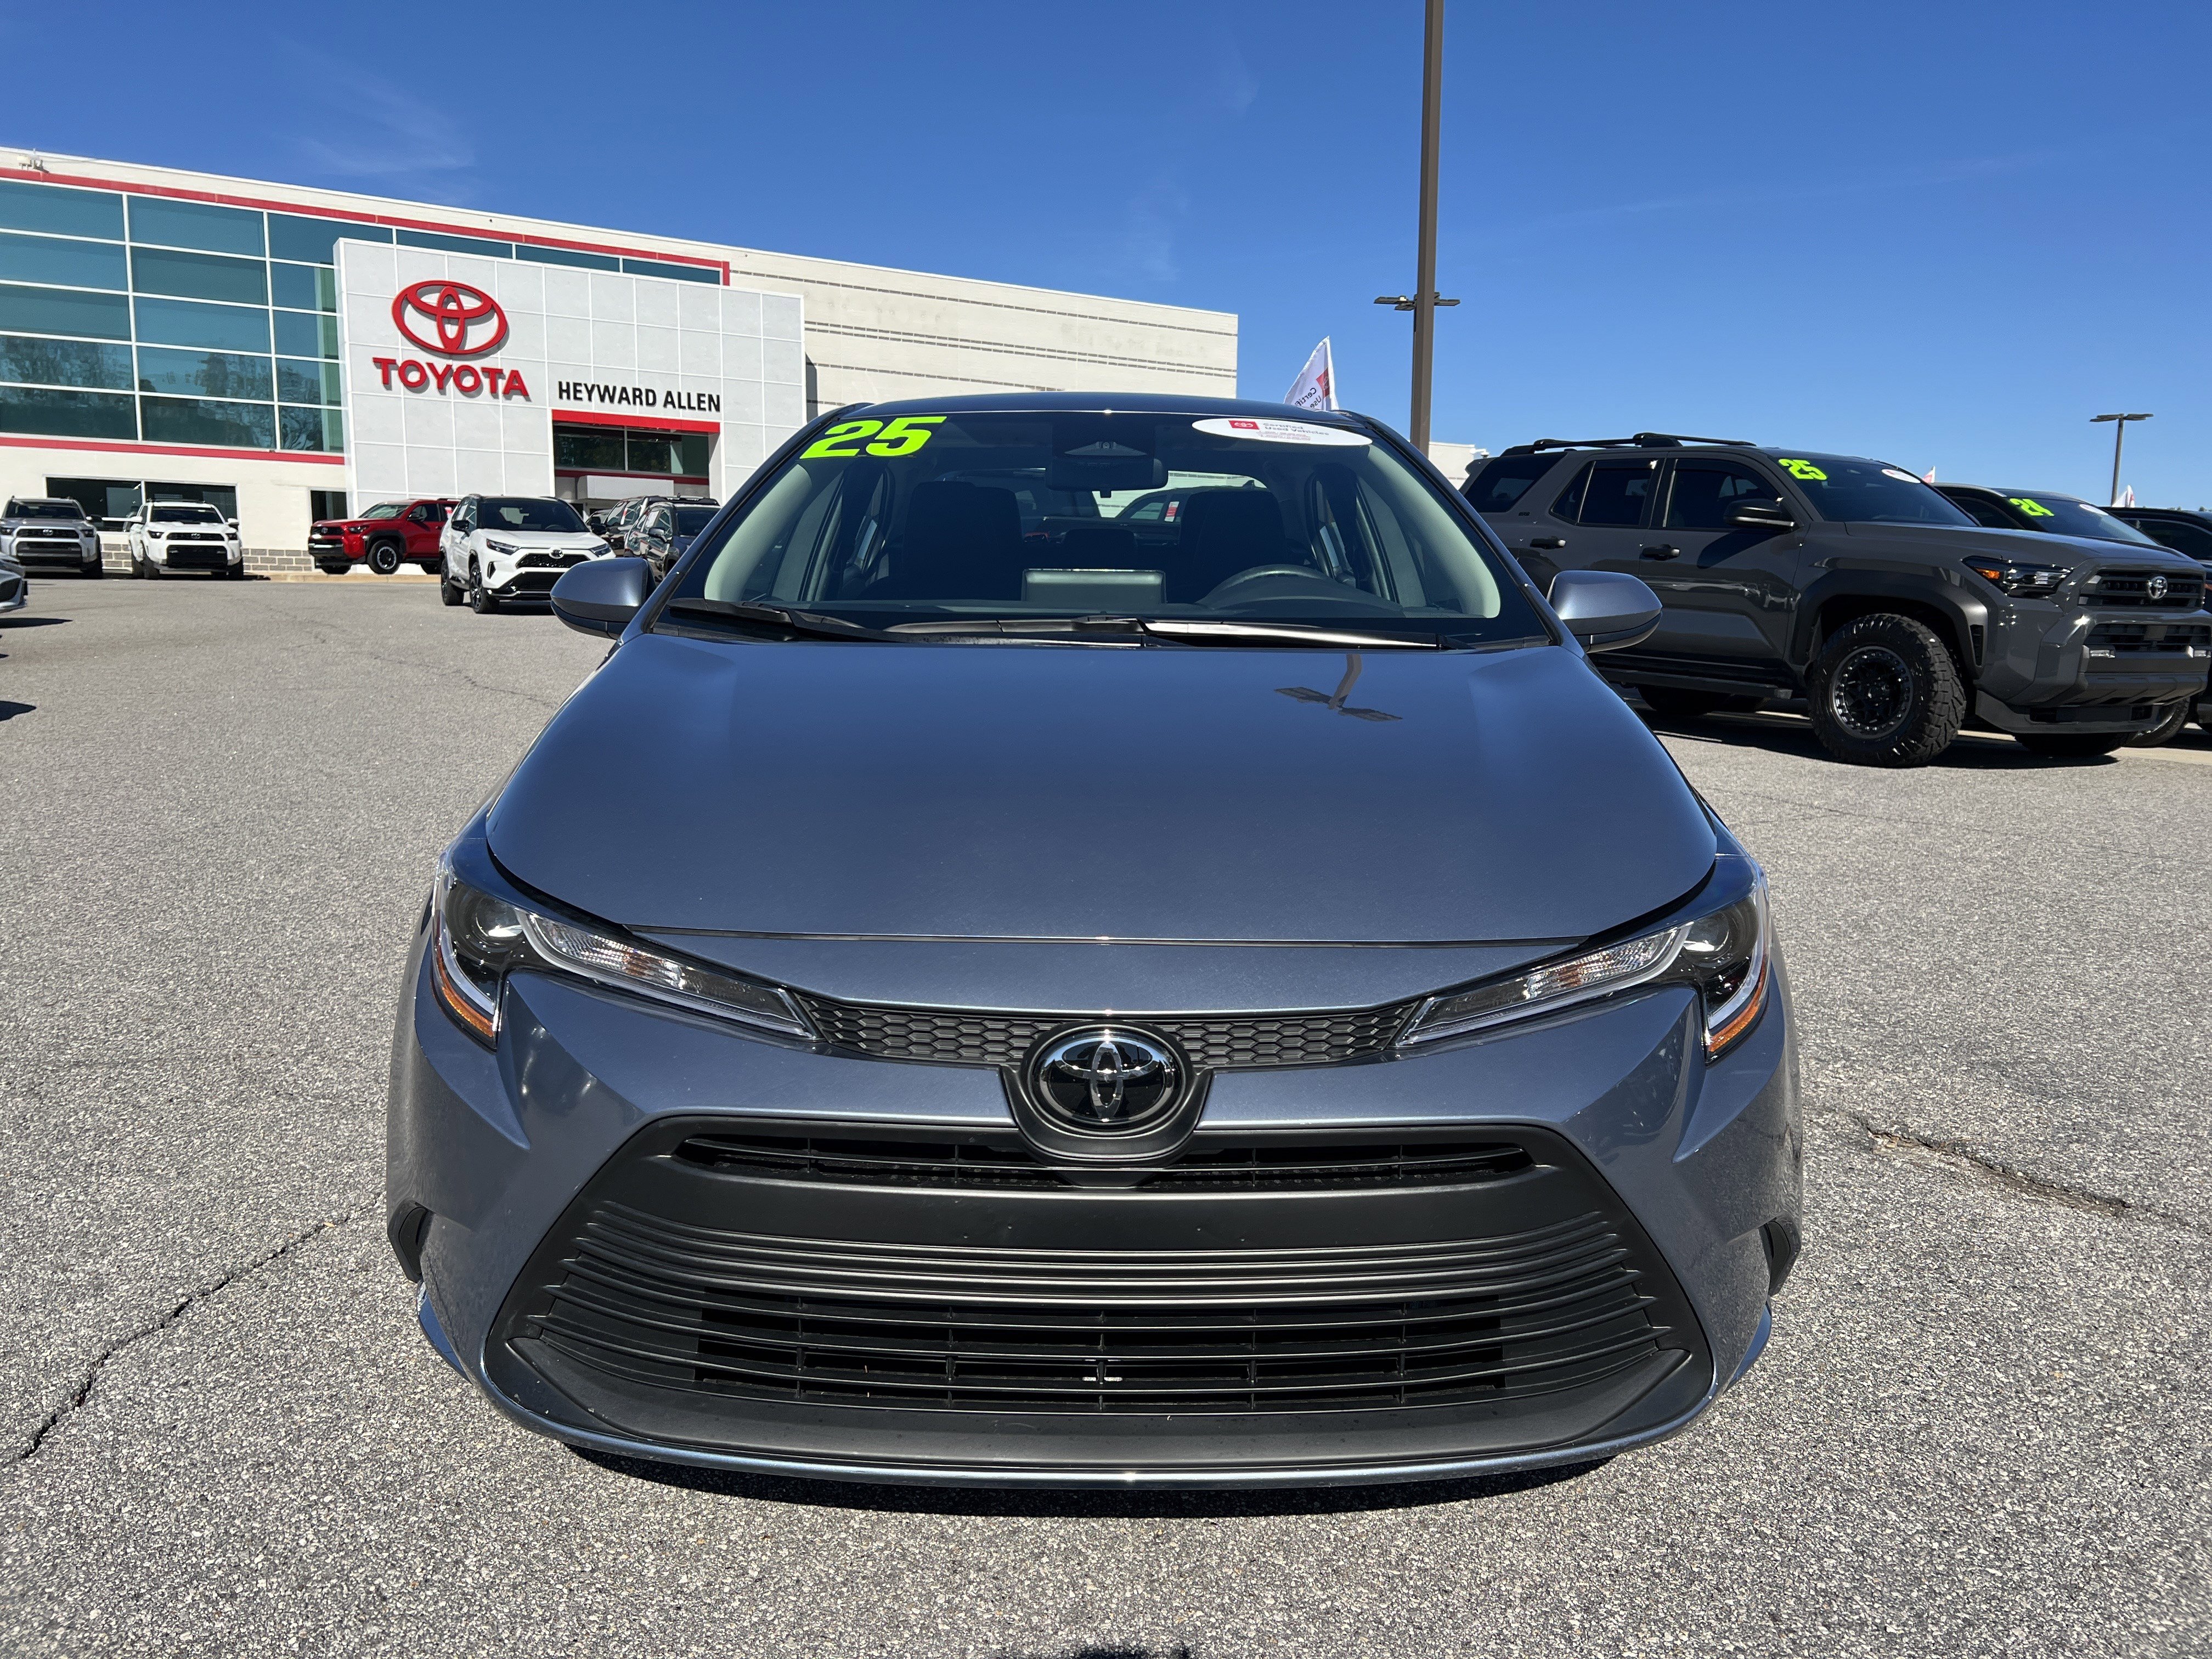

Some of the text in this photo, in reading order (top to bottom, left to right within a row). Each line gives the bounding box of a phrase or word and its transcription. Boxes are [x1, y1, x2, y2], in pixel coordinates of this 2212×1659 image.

[373, 357, 530, 396] TOYOTA
[558, 381, 720, 412] HEYWARD ALLEN
[800, 416, 947, 459] 25
[1779, 459, 1827, 481] 25
[2010, 498, 2055, 516] 24
